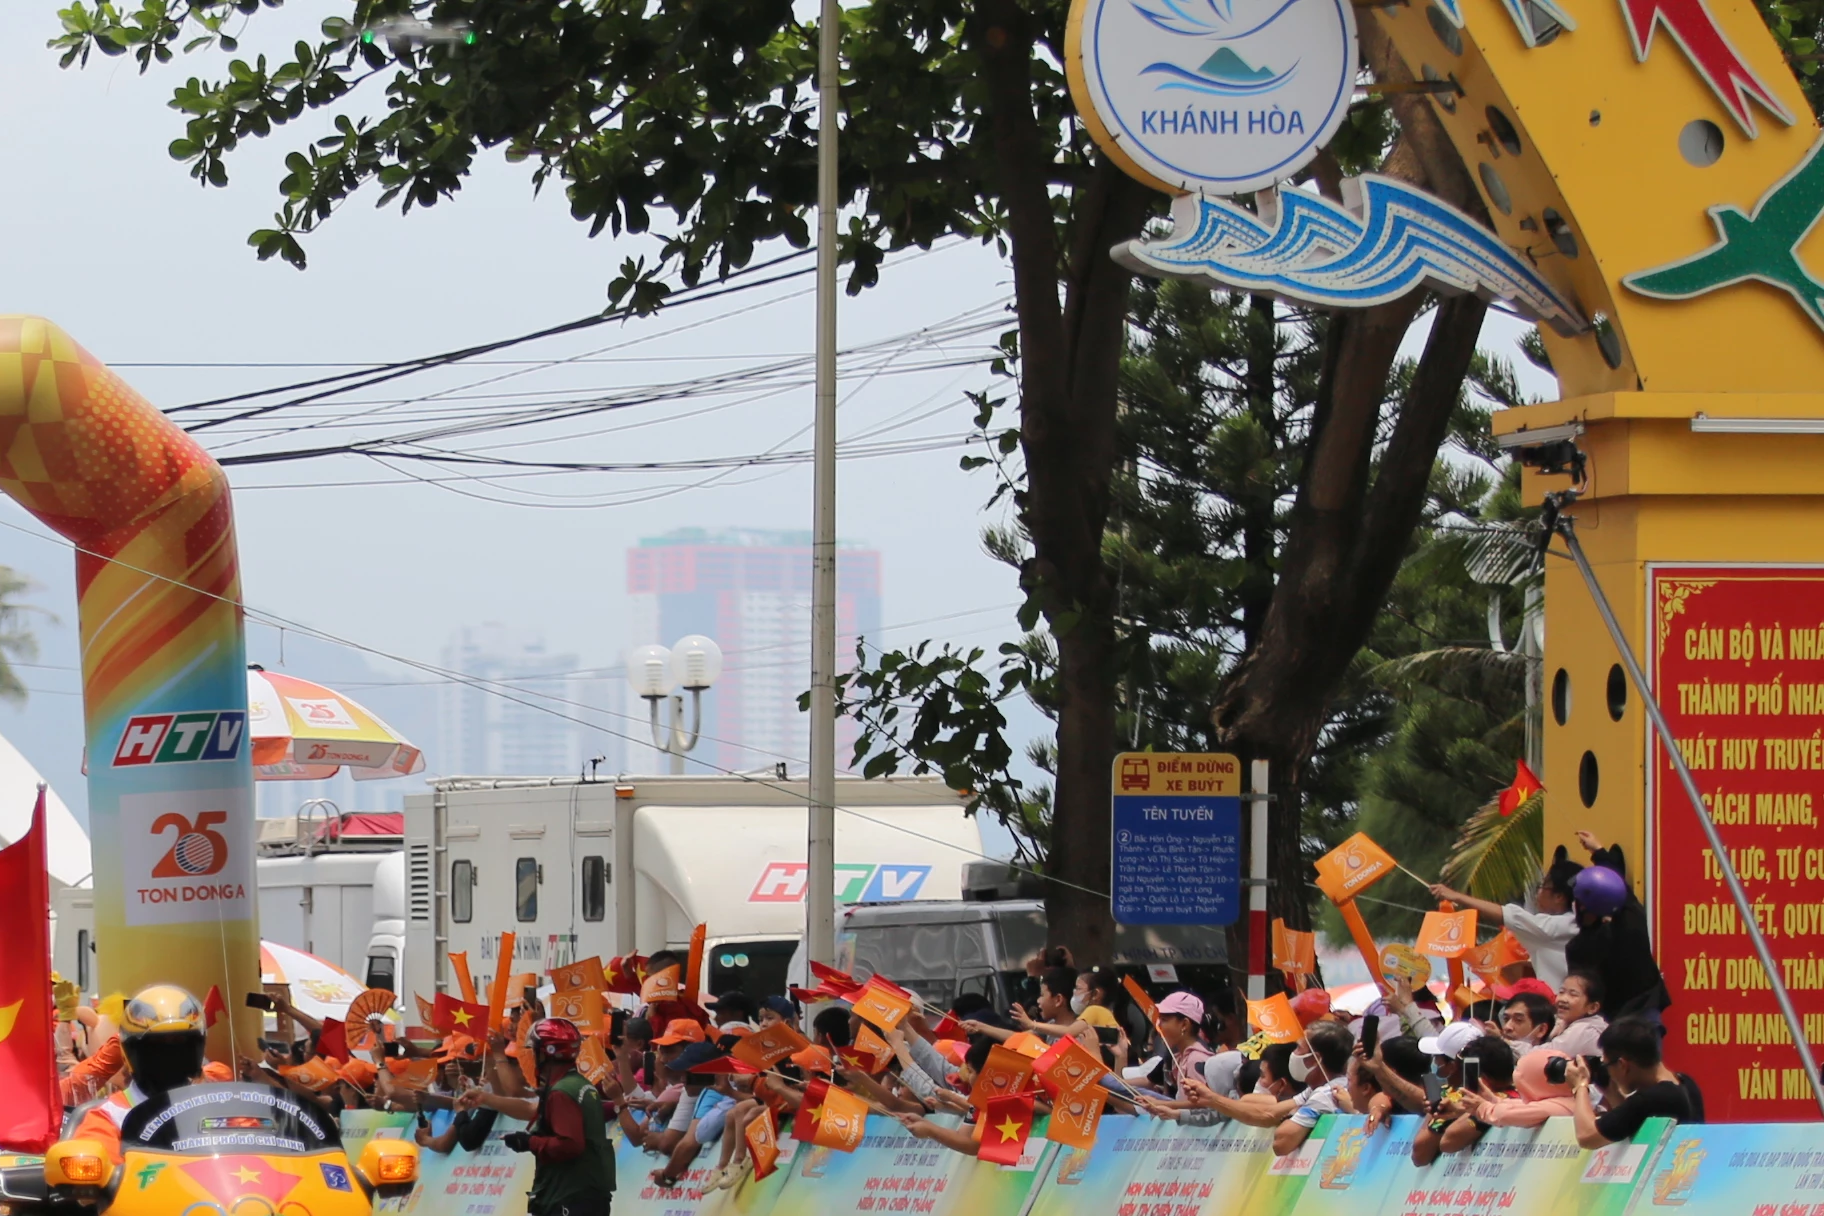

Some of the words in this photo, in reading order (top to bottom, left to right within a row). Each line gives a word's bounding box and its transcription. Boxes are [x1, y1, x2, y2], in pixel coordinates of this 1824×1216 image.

[1142, 104, 1238, 135] KHÁNH
[1248, 105, 1304, 135] HÒA
[1685, 621, 1723, 660] CÁN
[1729, 621, 1754, 667] BỘ
[1760, 621, 1785, 660] VÀ
[1678, 676, 1739, 715] THÀNH
[1745, 672, 1783, 715] PHỐ
[119, 717, 244, 761] HTV
[1722, 739, 1759, 770] HUY
[1764, 728, 1824, 770] TRUYỀ
[1157, 757, 1192, 773] ĐIỂM
[1197, 758, 1234, 774] DỪNG
[1166, 780, 1183, 791] XE
[1188, 777, 1224, 792] BUÝT
[1143, 806, 1167, 820] TÊN
[1172, 805, 1214, 821] TUYẾN
[1701, 787, 1750, 825] CÁCH
[1756, 793, 1818, 832] MẠNG,
[150, 810, 229, 878] 25
[1120, 832, 1129, 843] 2
[1334, 841, 1367, 880] 25
[1776, 845, 1802, 887] TỰ
[138, 887, 178, 904] TON
[182, 885, 233, 902] DONG
[235, 884, 245, 899] A
[755, 867, 927, 898] HTV
[1435, 916, 1465, 943] 25
[1684, 897, 1736, 935] ĐOÀN
[1428, 943, 1443, 952] TON
[1684, 952, 1720, 989] XÂY
[1687, 1007, 1730, 1044] GIÀU
[1053, 1055, 1087, 1086] 25
[1738, 1062, 1777, 1099] VĂN
[1057, 1093, 1087, 1128] 25
[276, 1137, 306, 1152] MINH
[1082, 1120, 1093, 1137] TON
